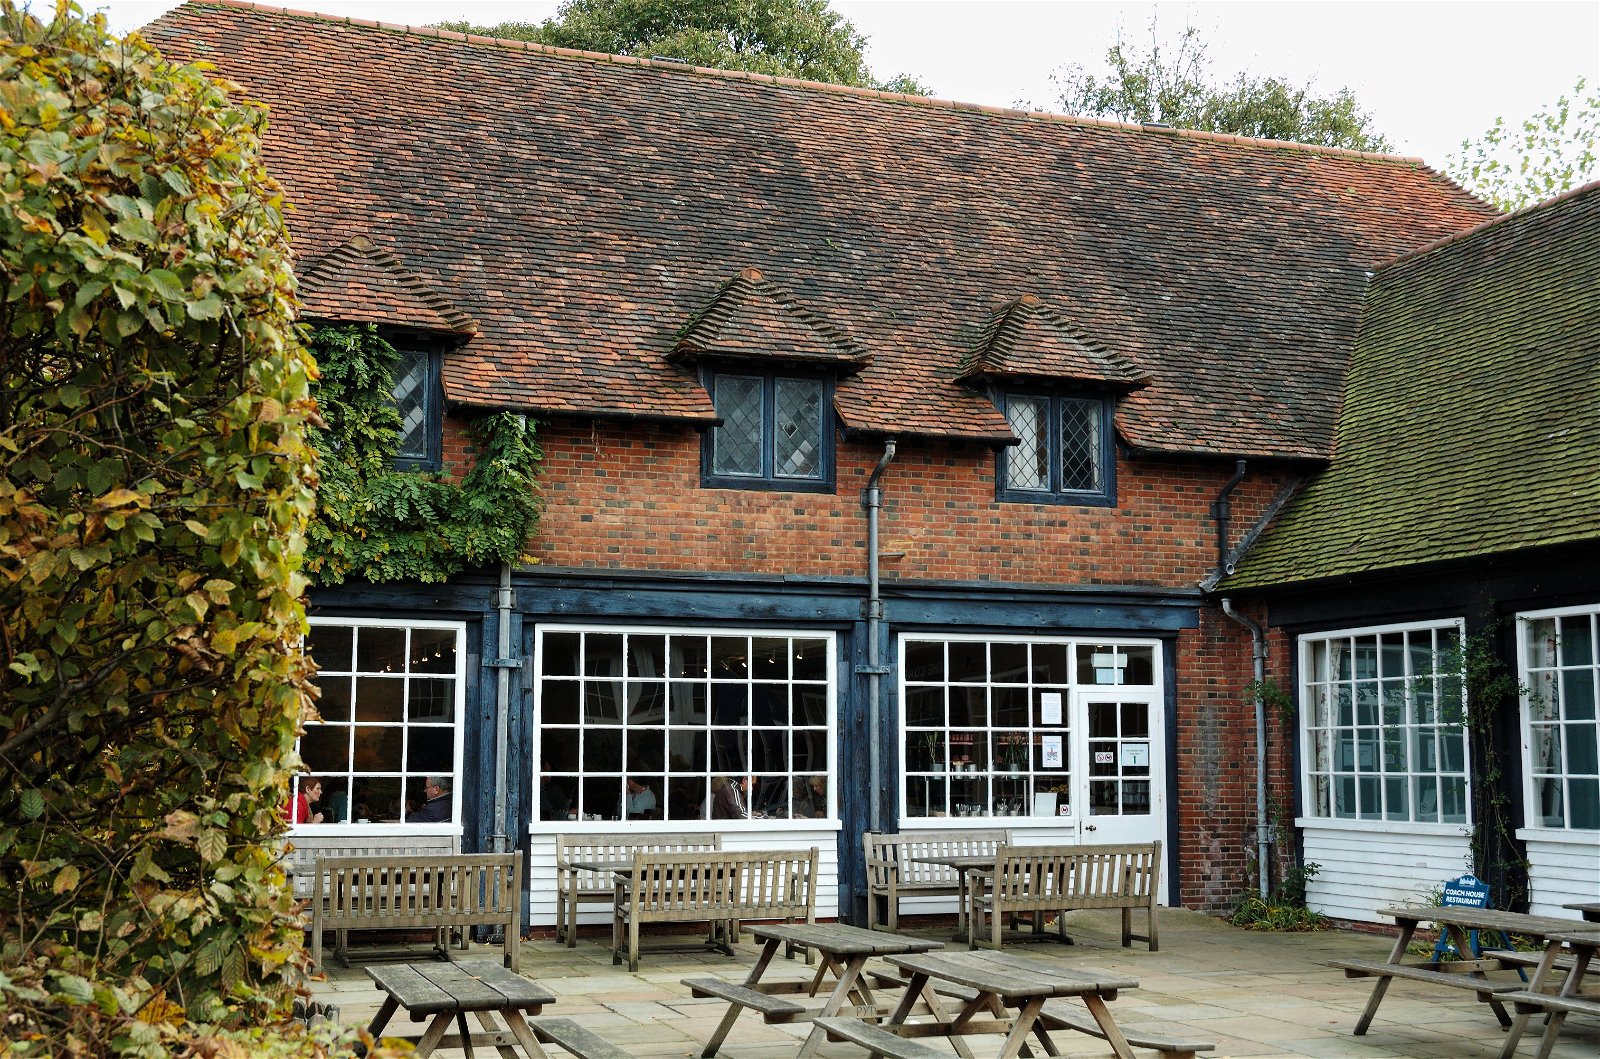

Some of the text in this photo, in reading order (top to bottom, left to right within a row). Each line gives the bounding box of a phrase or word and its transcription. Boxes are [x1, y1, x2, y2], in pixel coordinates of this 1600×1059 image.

[1445, 888, 1486, 899] COACH HOUSE
[1445, 895, 1482, 906] RESTAURANT
